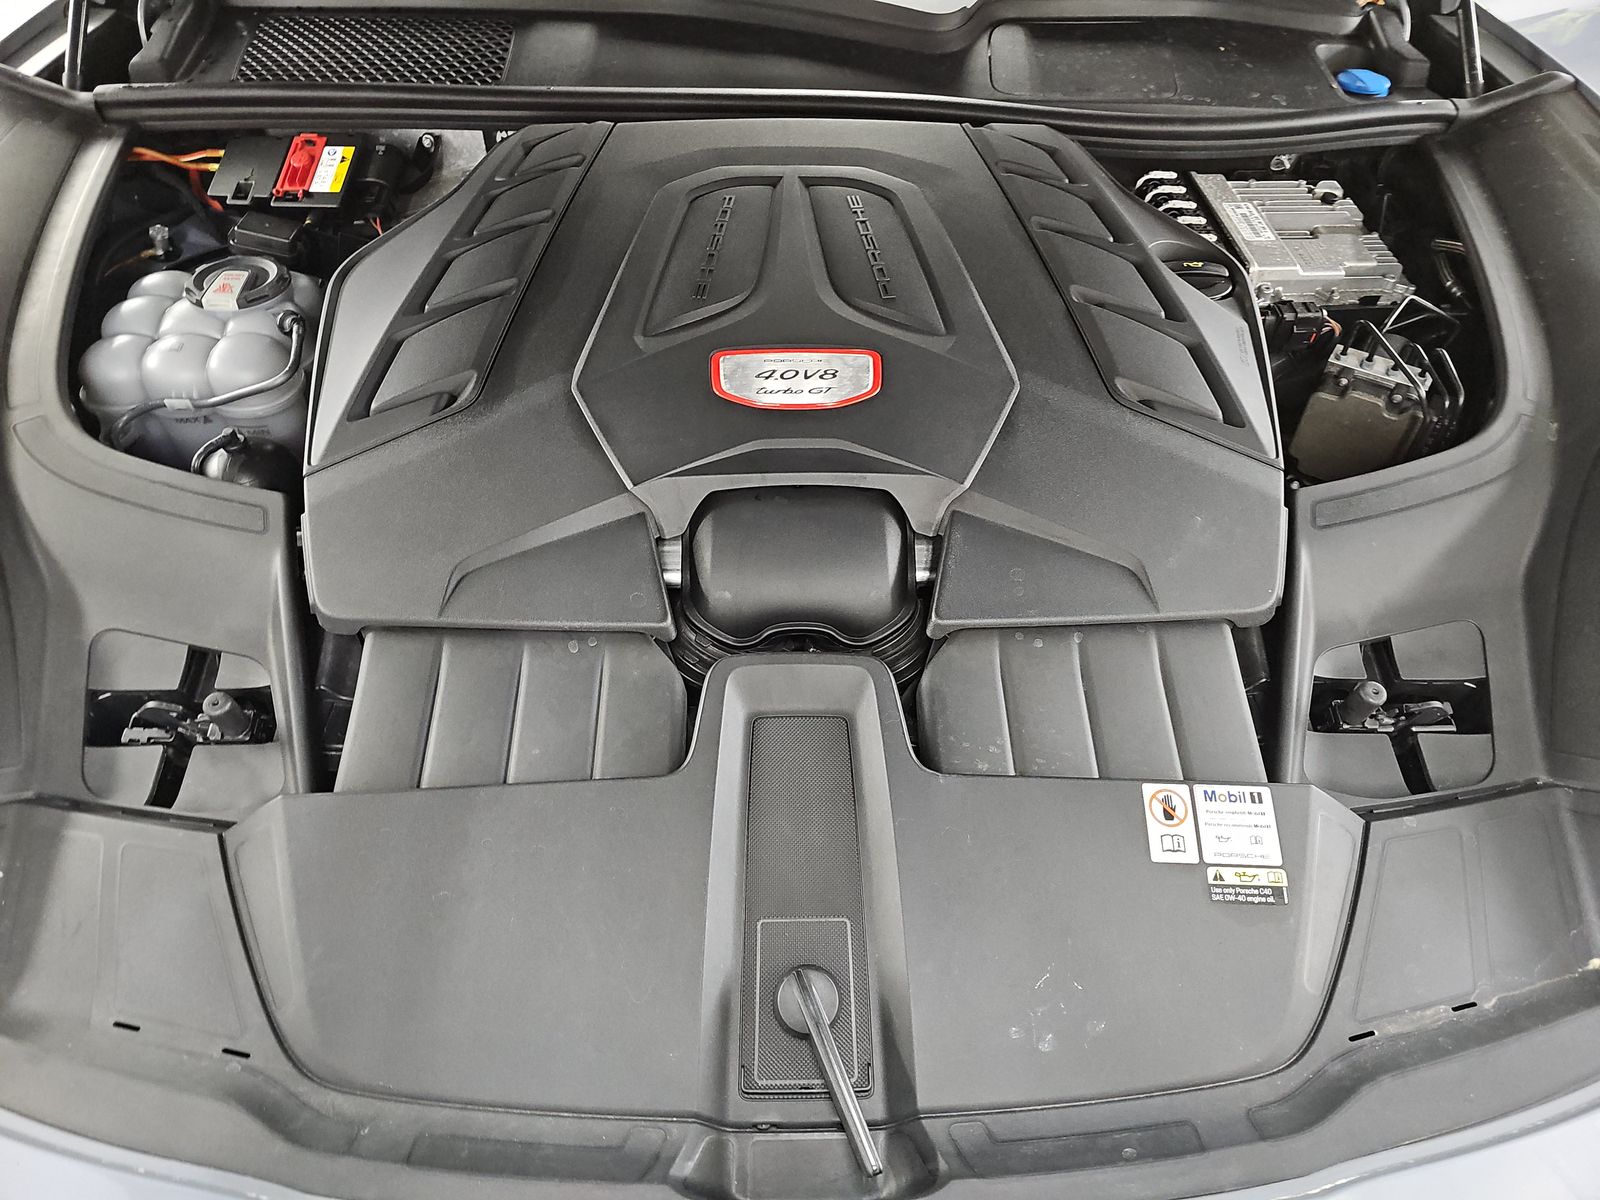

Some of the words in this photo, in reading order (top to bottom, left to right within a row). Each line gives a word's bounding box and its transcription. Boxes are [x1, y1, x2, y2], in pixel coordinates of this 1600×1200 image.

[846, 195, 897, 299] PORSCHE
[755, 387, 804, 395] turbo
[808, 386, 839, 395] GT
[1203, 789, 1247, 803] Mobil
[1223, 887, 1235, 895] only
[1236, 887, 1259, 895] Porsche
[1225, 894, 1246, 902] 0W-40
[1247, 896, 1266, 904] engine
